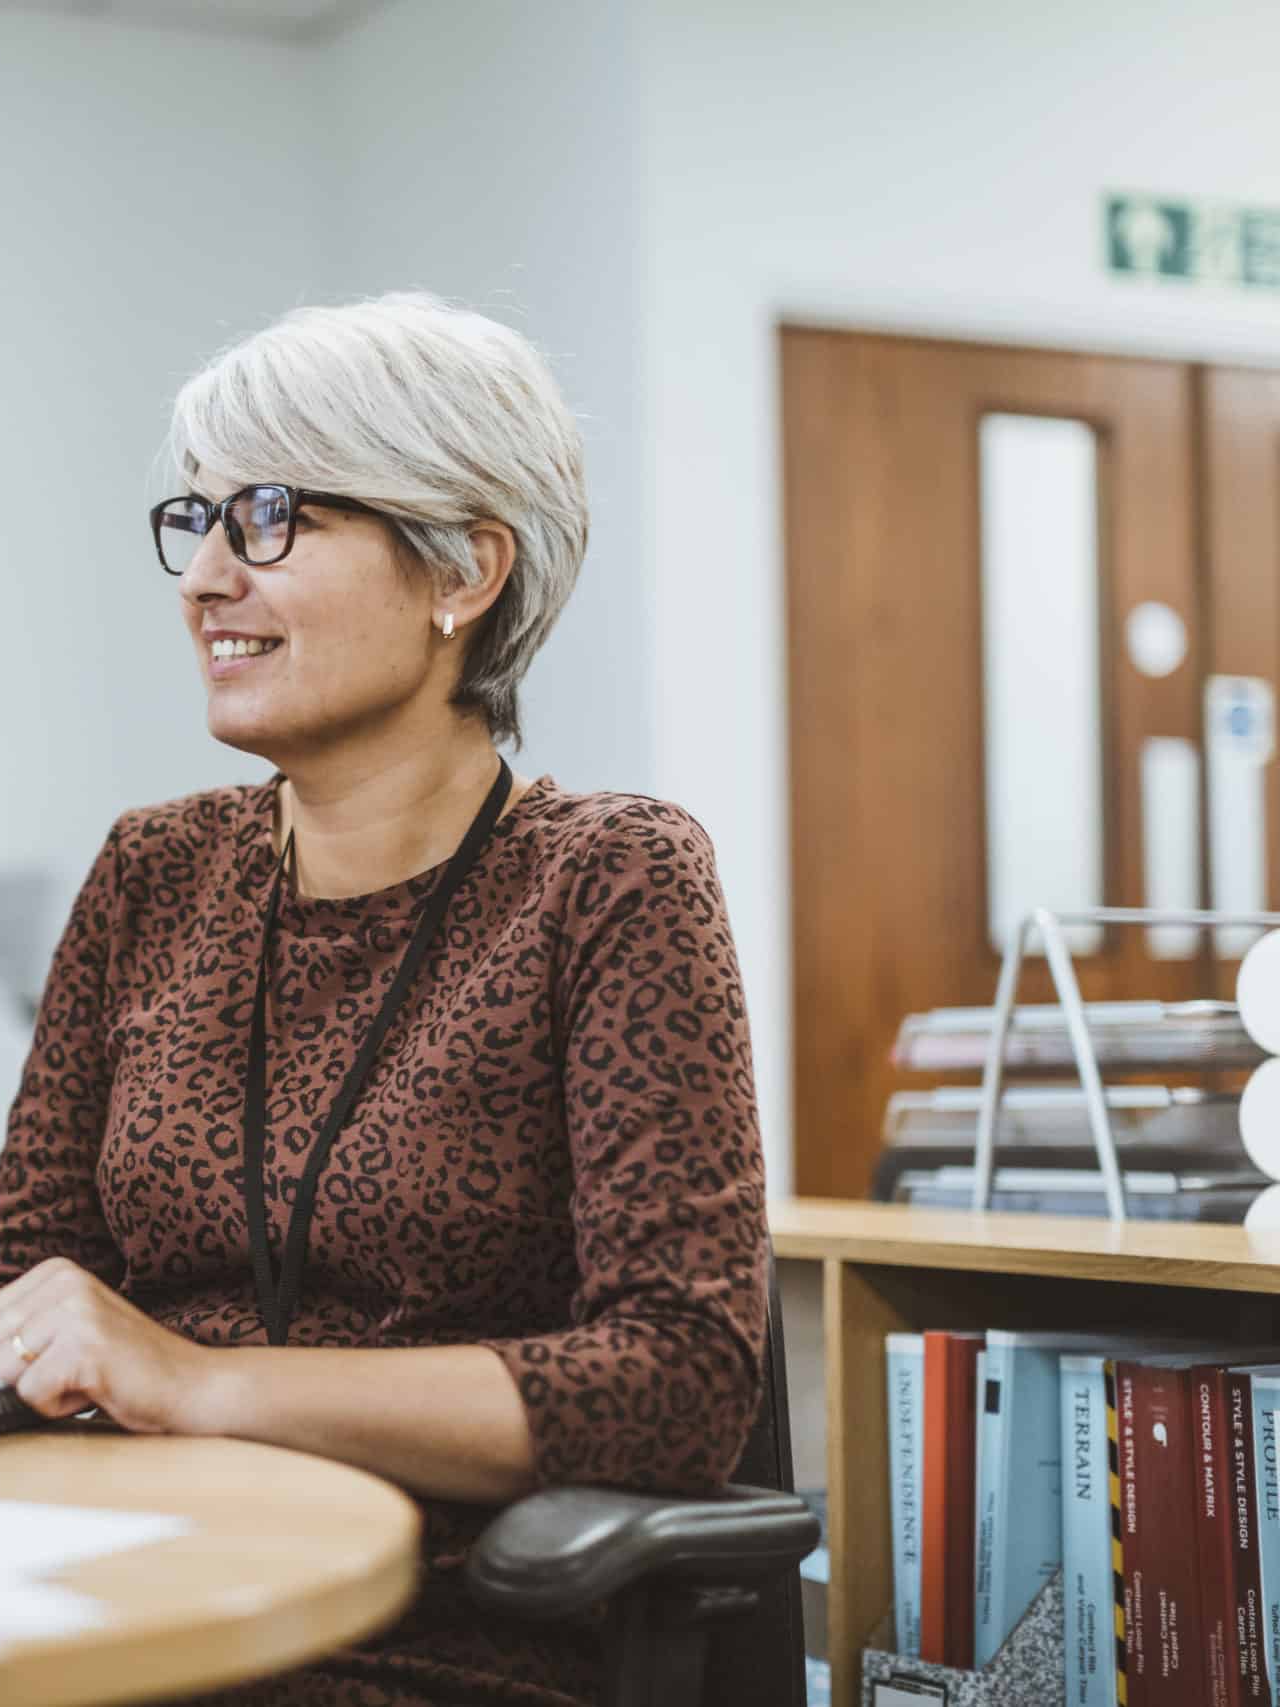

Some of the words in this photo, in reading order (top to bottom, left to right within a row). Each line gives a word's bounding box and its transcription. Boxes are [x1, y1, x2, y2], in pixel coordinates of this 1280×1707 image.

[1200, 1384, 1214, 1450] CONTOUR
[1074, 1388, 1092, 1501] TERRAIN
[1125, 1439, 1135, 1480] STYLE
[1203, 1453, 1213, 1463] &
[1234, 1439, 1244, 1447] &
[898, 1369, 918, 1566] INDEPENDENCE
[1235, 1452, 1246, 1494] STYLE
[1262, 1410, 1280, 1520] PROFILE
[1126, 1483, 1136, 1533] DESIGN
[1204, 1466, 1216, 1518] MATRIX
[1237, 1497, 1249, 1549] DESIGN
[1133, 1571, 1144, 1619] Contract
[1159, 1591, 1168, 1639] Contract
[1168, 1601, 1177, 1626] Tiles
[1247, 1589, 1257, 1639] Contract
[1237, 1607, 1248, 1646] Carpet
[1161, 1642, 1170, 1678] Heavy
[1170, 1631, 1179, 1669] Carpet
[1239, 1649, 1248, 1676] Tiles
[1249, 1642, 1259, 1673] Loop
[1251, 1675, 1261, 1696] Pile
